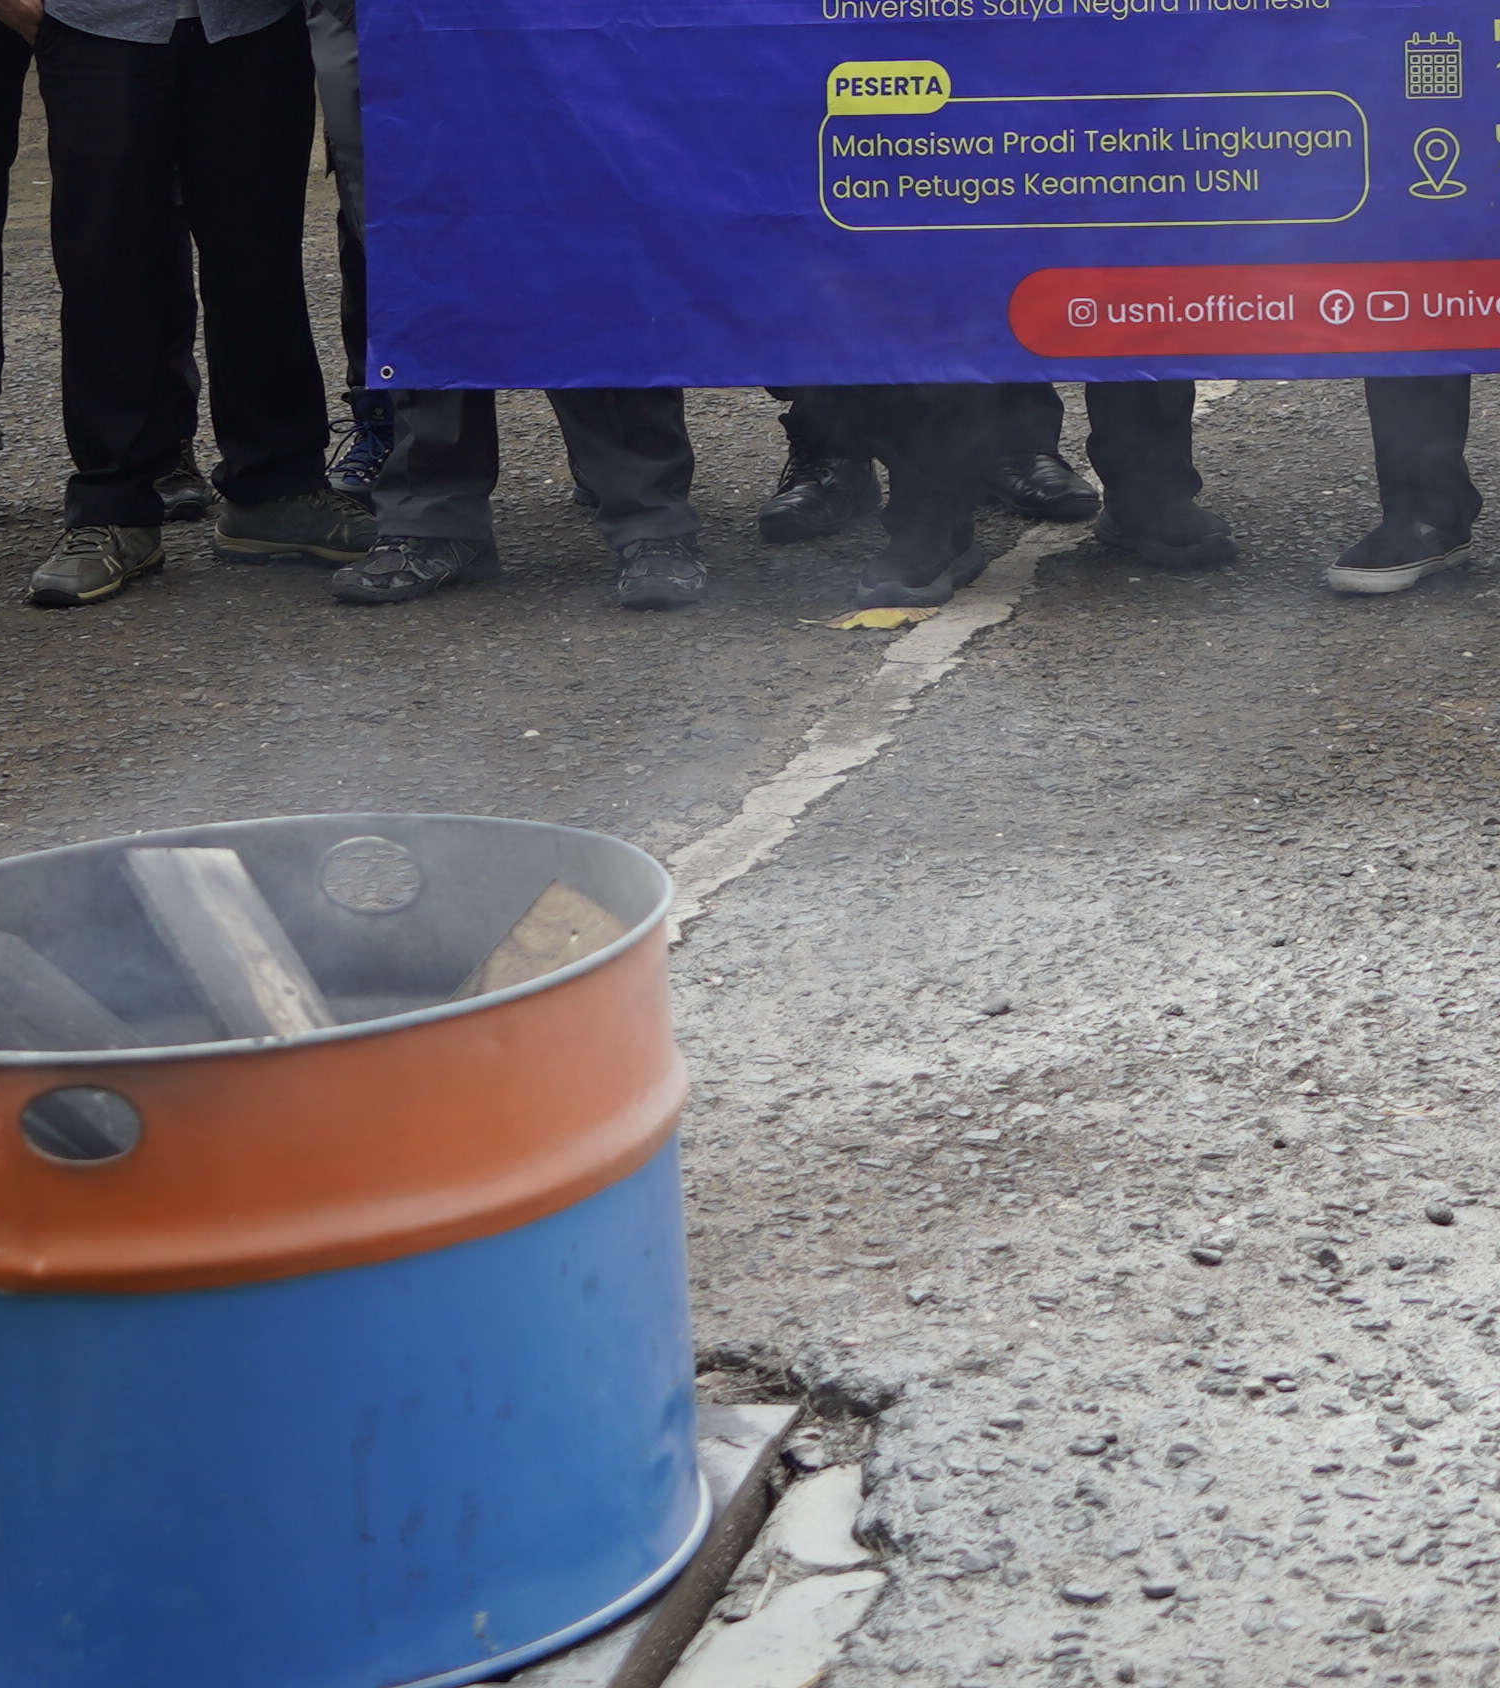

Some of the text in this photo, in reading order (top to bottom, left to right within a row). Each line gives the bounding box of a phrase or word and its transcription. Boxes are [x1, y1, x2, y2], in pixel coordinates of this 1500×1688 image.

[835, 75, 944, 97] PESERTA
[832, 126, 1352, 158] Mahasiswa Prodi Teknik Lingkungan
[832, 168, 1259, 204] dan Petugas Keamanan USNI
[1107, 294, 1294, 324] usni.official
